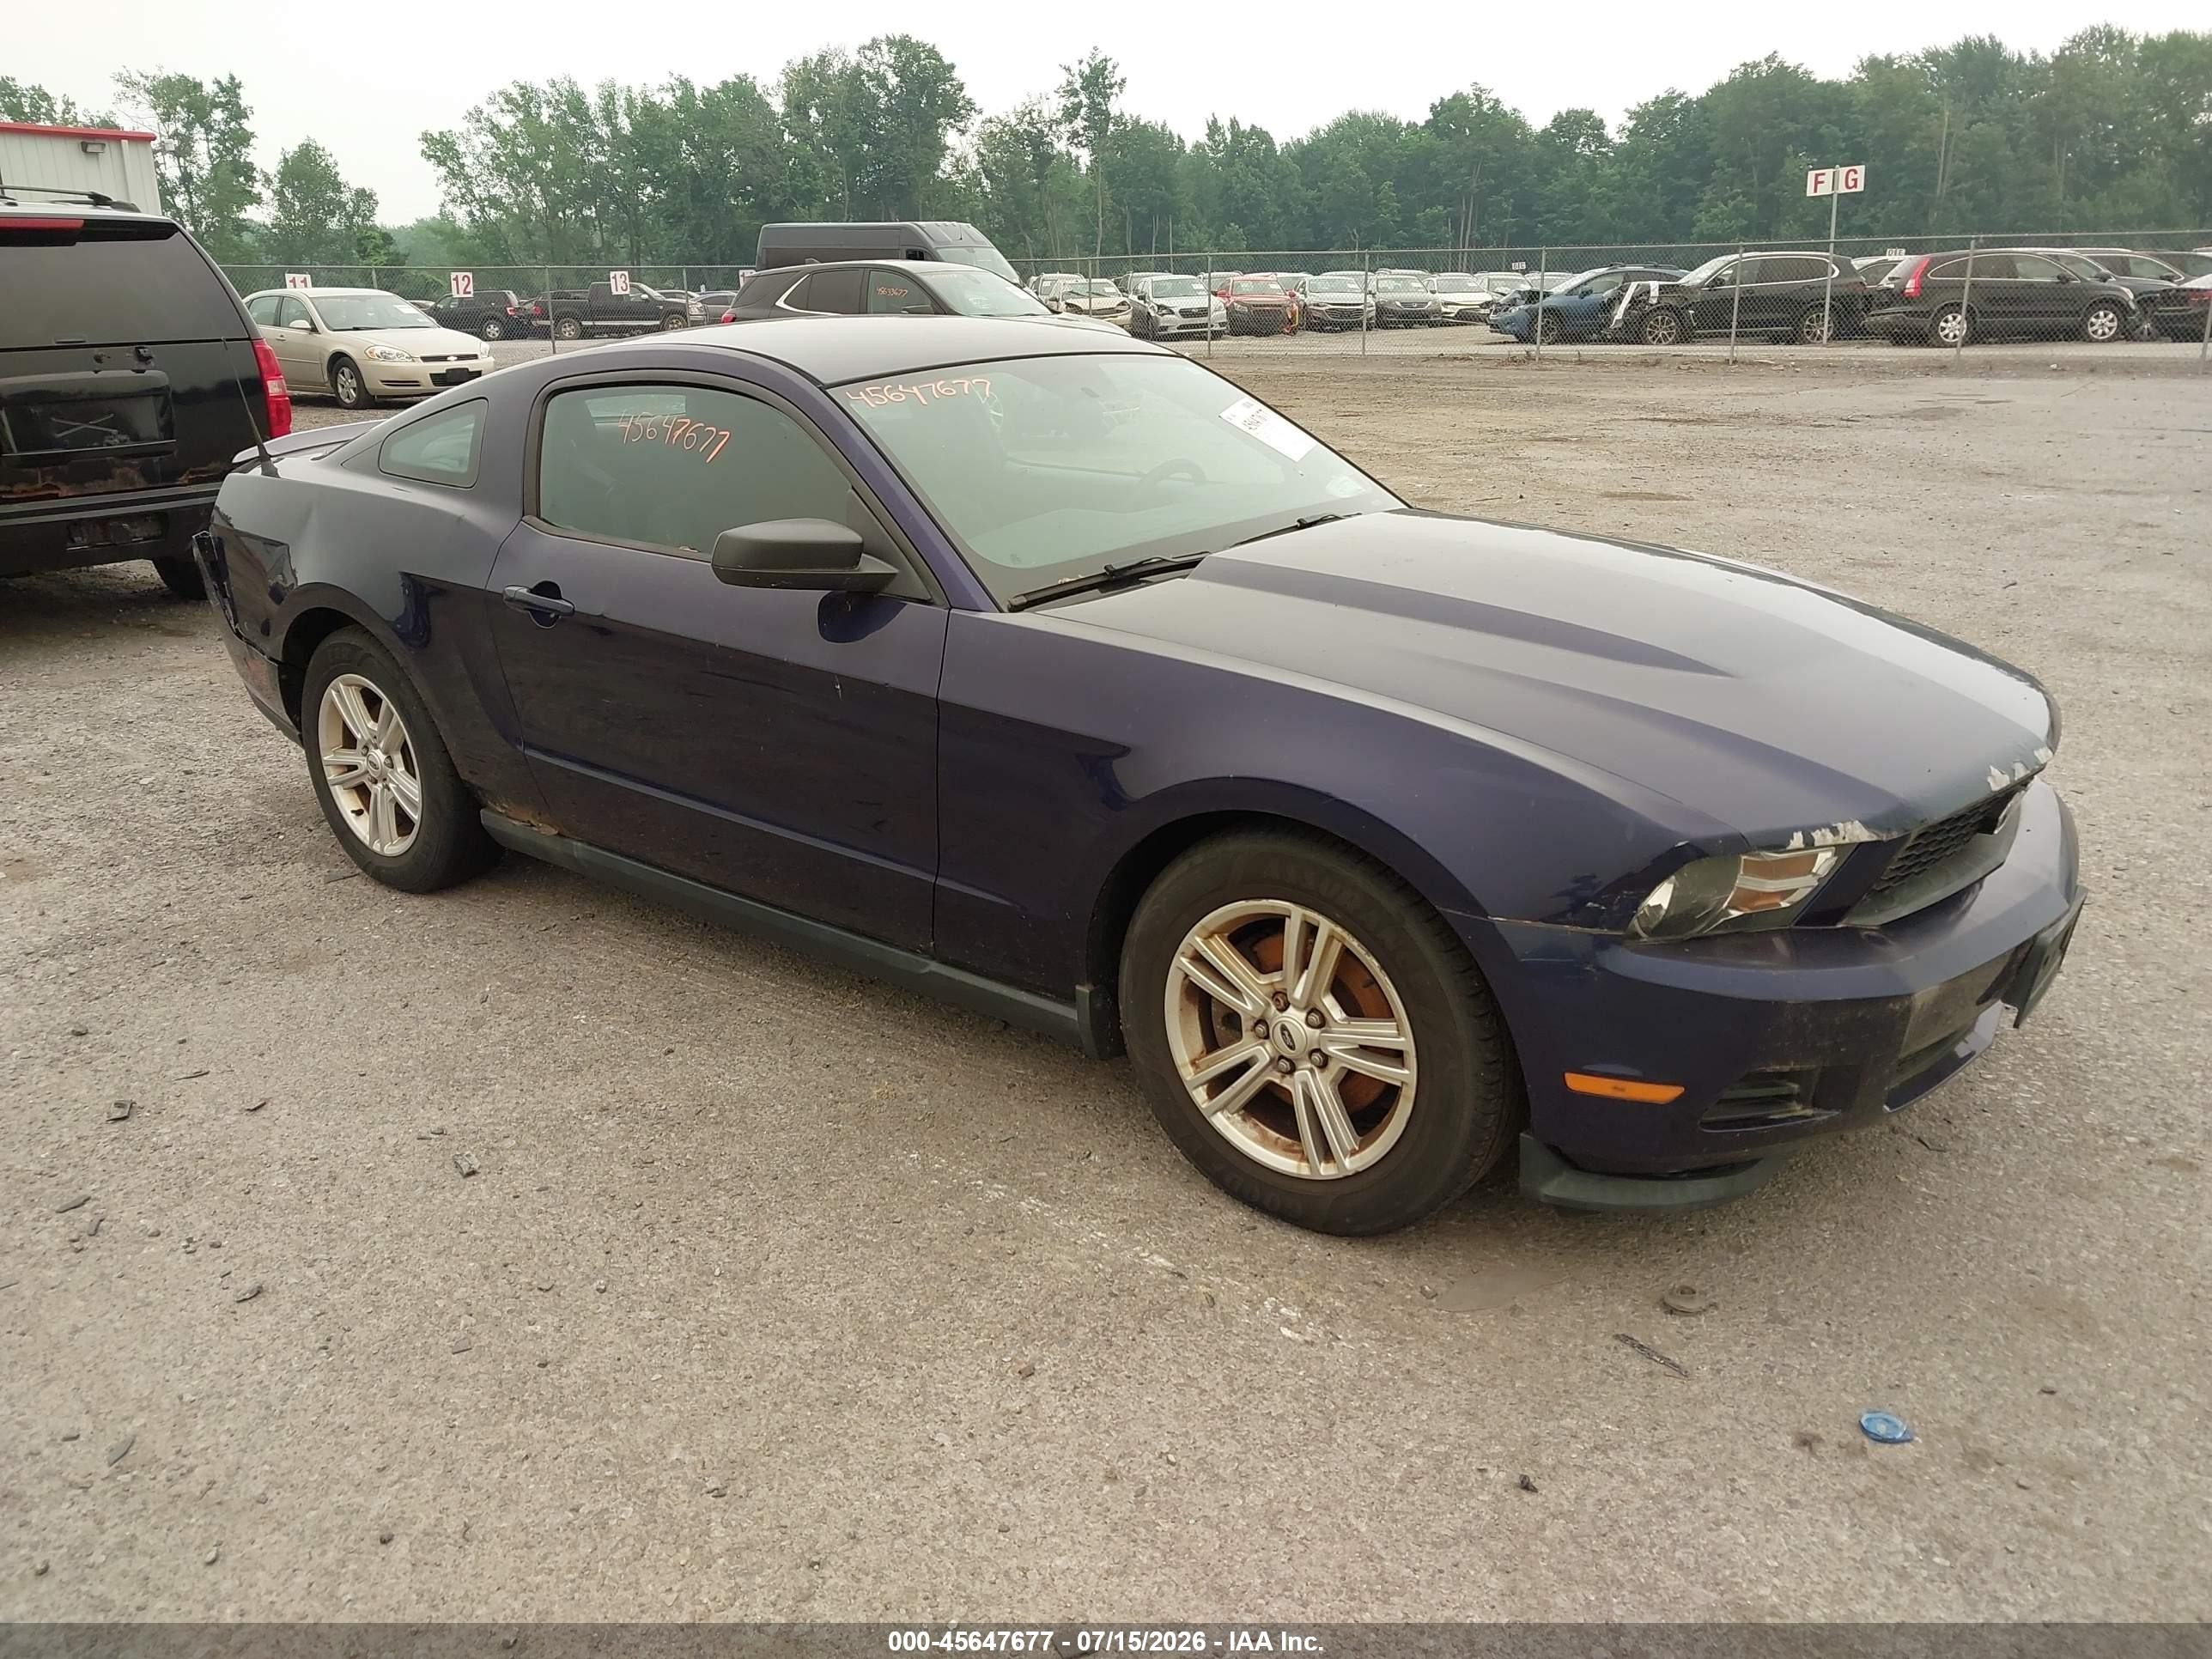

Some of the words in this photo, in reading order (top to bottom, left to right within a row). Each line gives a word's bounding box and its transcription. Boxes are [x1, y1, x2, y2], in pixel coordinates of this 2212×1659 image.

[1814, 173, 1826, 193] F
[1844, 168, 1858, 190] G
[289, 276, 308, 289] 11
[453, 274, 471, 295] 12
[611, 273, 628, 292] 13
[846, 378, 991, 408] 45647677
[618, 409, 730, 464] 45647677
